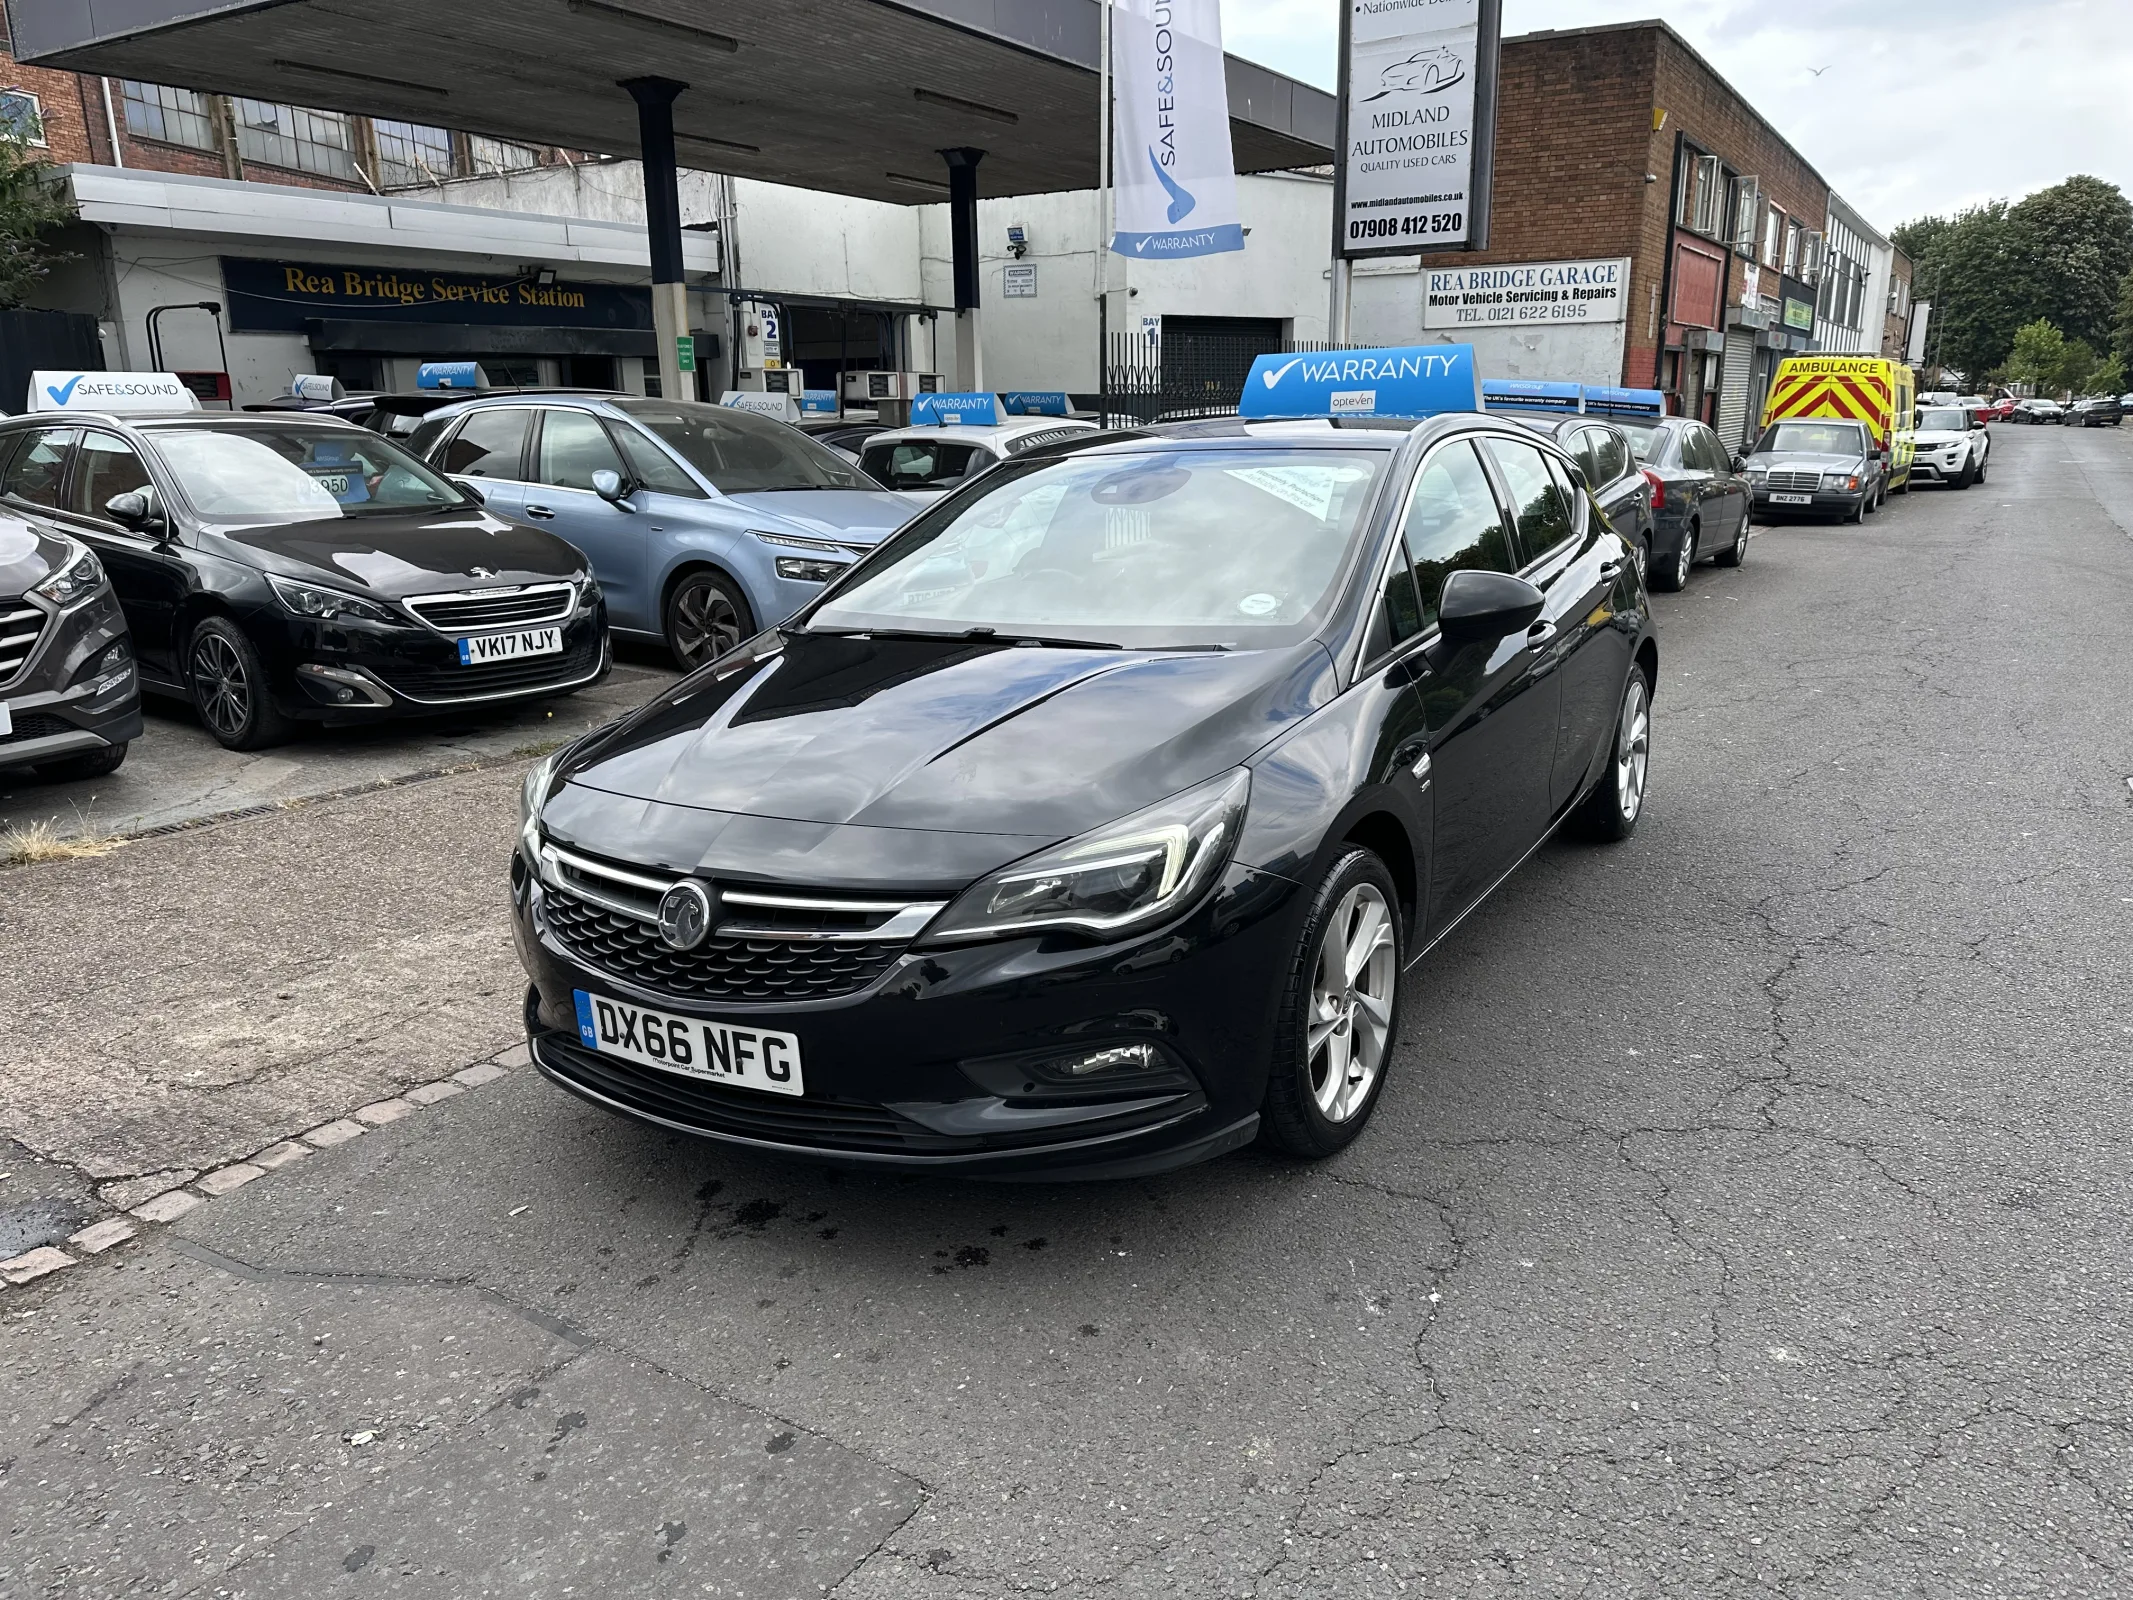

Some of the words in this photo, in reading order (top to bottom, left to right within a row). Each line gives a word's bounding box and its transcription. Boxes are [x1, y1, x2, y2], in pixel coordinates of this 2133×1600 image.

[1371, 105, 1450, 129] MIDLAND
[1351, 129, 1468, 157] AUTOMOBILES
[1360, 159, 1401, 173] QUALITY
[1403, 156, 1429, 168] USED
[1431, 154, 1457, 165] CARS
[1351, 191, 1463, 209] www.midlandautomobiles.co.uk
[1350, 217, 1398, 239] 07908
[1401, 215, 1428, 235] 412
[1431, 212, 1462, 233] 520
[1152, 232, 1215, 250] WARRANTY
[1430, 273, 1464, 292] REA
[1469, 268, 1535, 290] BRIDGE
[1540, 264, 1618, 286] GARAGE
[283, 267, 336, 294] Rea
[344, 270, 426, 305] Bridge
[431, 277, 510, 304] Service
[518, 283, 585, 308] Station
[1429, 294, 1459, 307] Motor
[1462, 291, 1503, 305] Vehicle
[1505, 289, 1558, 304] Servicing
[1561, 289, 1570, 300] &
[1573, 286, 1617, 301] Repairs
[761, 310, 779, 319] BAY
[1143, 317, 1160, 326] BAY
[1456, 309, 1485, 322] TEL.
[1487, 307, 1515, 321] 0121
[1519, 305, 1549, 320] 622
[1551, 304, 1588, 318] 6195
[766, 320, 777, 339] 2
[1147, 327, 1155, 345] 1
[432, 365, 472, 375] WARRANTY
[1302, 354, 1459, 383] WARRANTY
[1789, 362, 1878, 374] AMBULANCE
[77, 383, 178, 396] SAFE&SOUND
[736, 401, 783, 412] SAFE&SOUND
[932, 397, 990, 410] WARRANTY
[1019, 395, 1062, 405] WARRANTY
[1332, 393, 1373, 407] opteven
[475, 635, 517, 658] VK17
[521, 629, 554, 652] NJY
[581, 1025, 594, 1038] GB
[595, 999, 693, 1065] DX66
[702, 1025, 791, 1083] NFG
[690, 1066, 725, 1078] Supermarket
